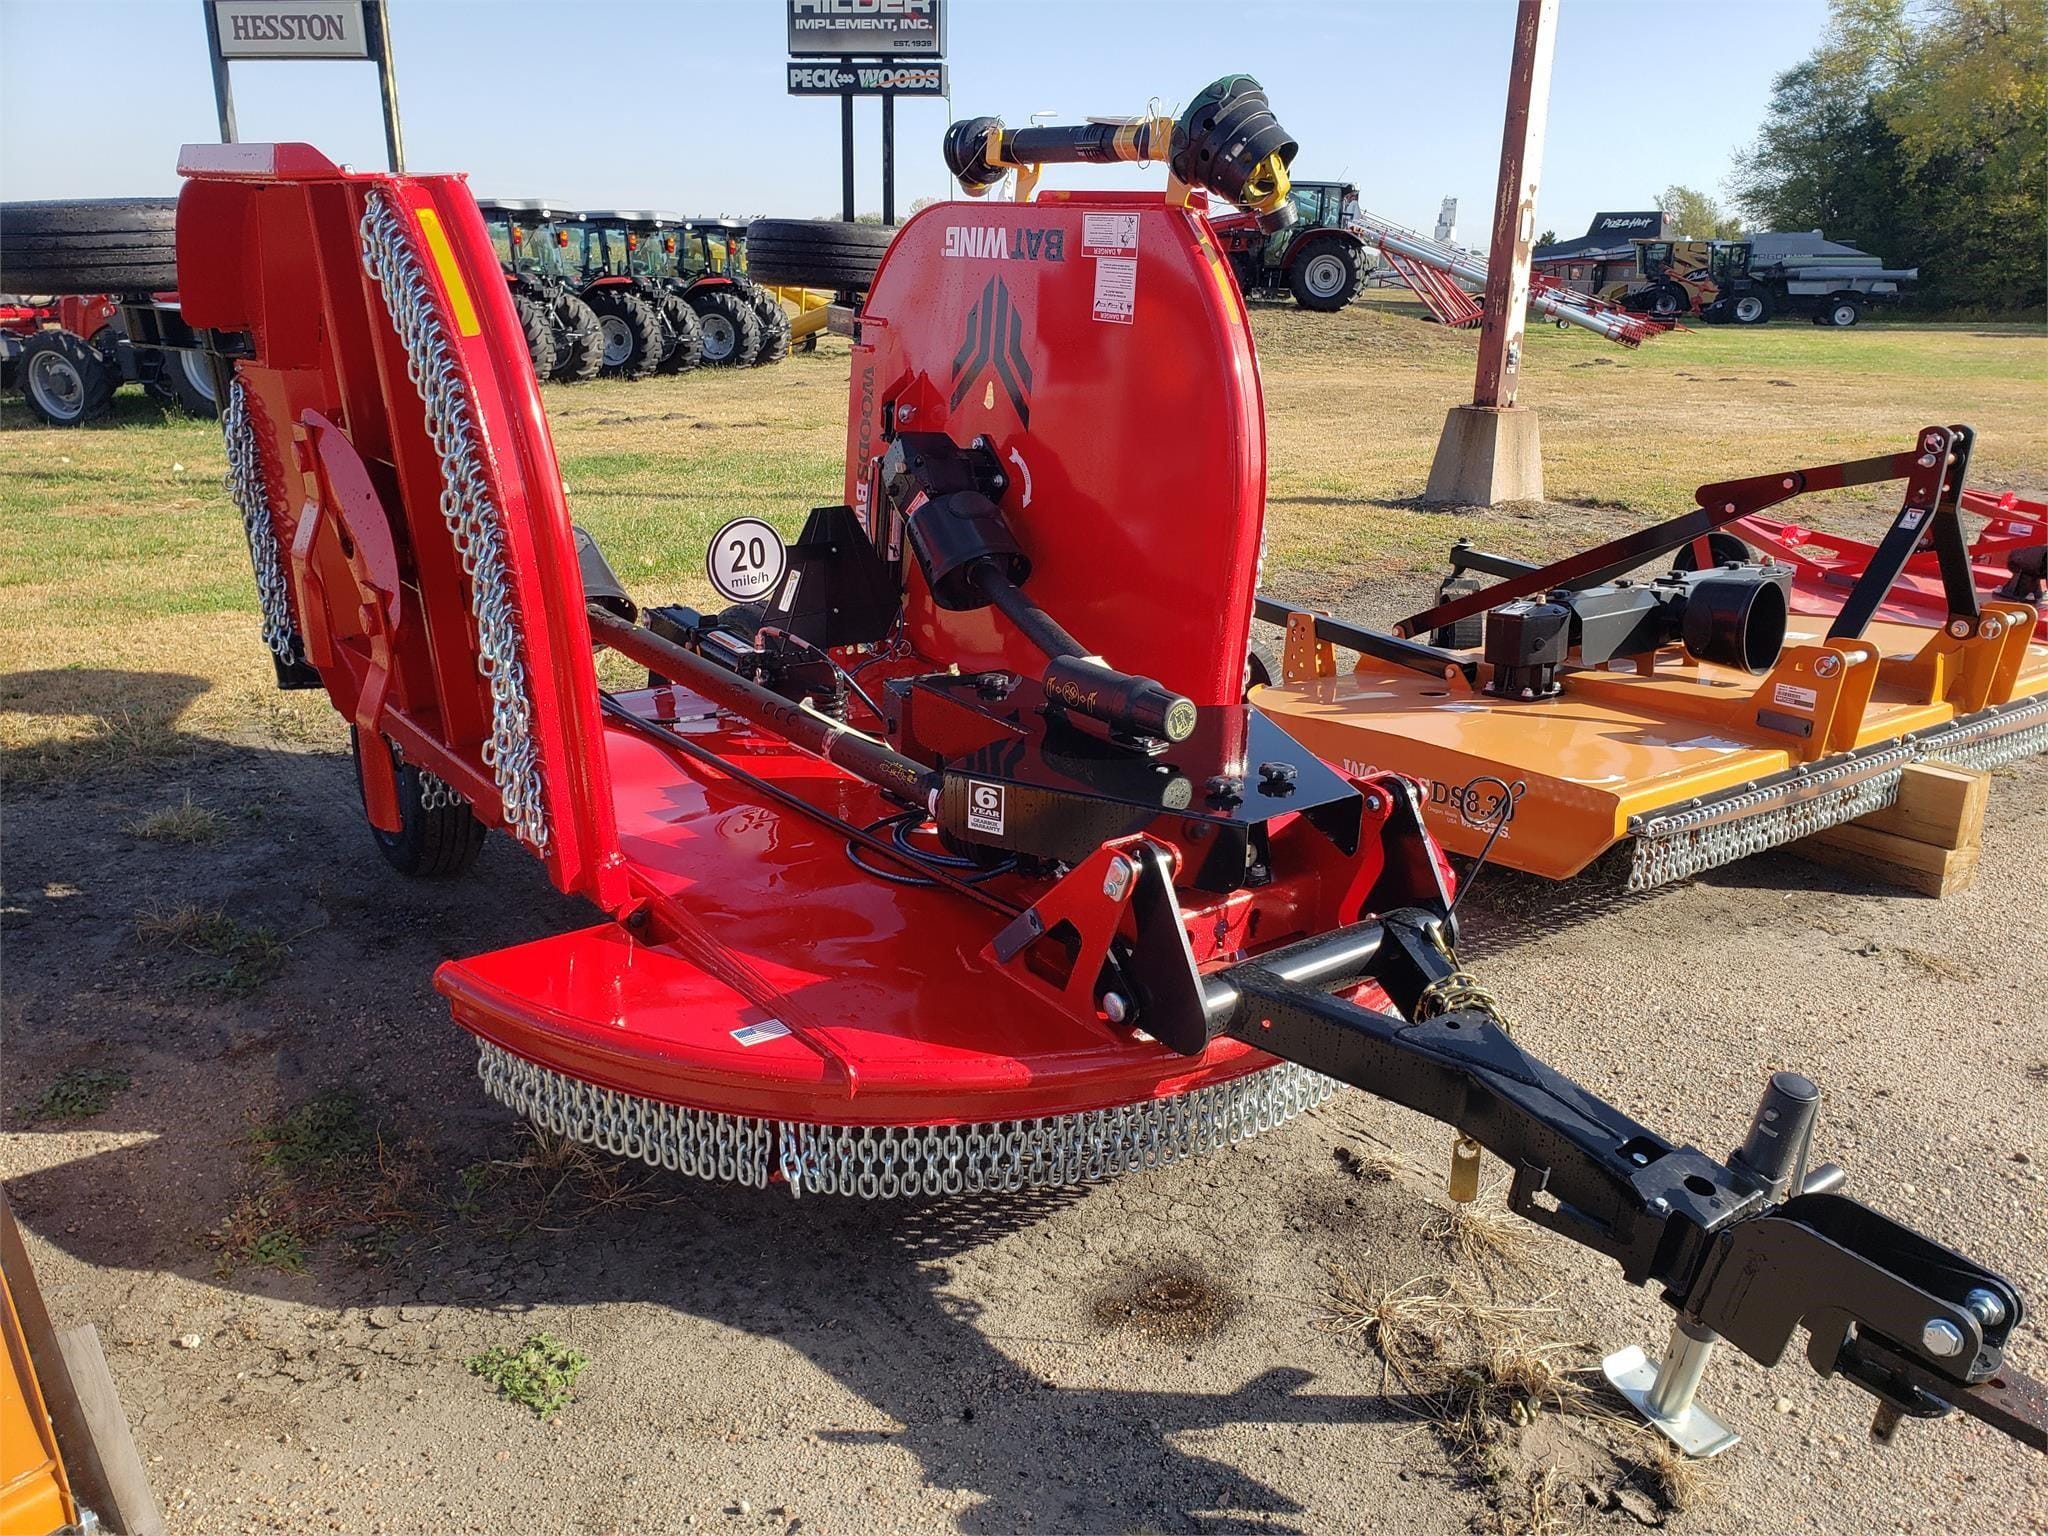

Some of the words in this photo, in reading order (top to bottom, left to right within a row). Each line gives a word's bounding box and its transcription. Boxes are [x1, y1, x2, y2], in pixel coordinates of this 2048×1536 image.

[231, 14, 344, 41] HESSTON
[796, 19, 897, 31] IMPLEMENT,
[900, 19, 933, 30] INC.
[790, 69, 839, 88] PECK
[857, 69, 940, 89] WOODS
[1093, 247, 1117, 256] DANGER
[729, 537, 766, 573] 20
[731, 572, 769, 588] mile/h
[975, 786, 998, 809] 6
[972, 806, 1000, 817] YEAR
[971, 822, 1001, 832] WARRANTY
[973, 818, 998, 827] GEARBOX
